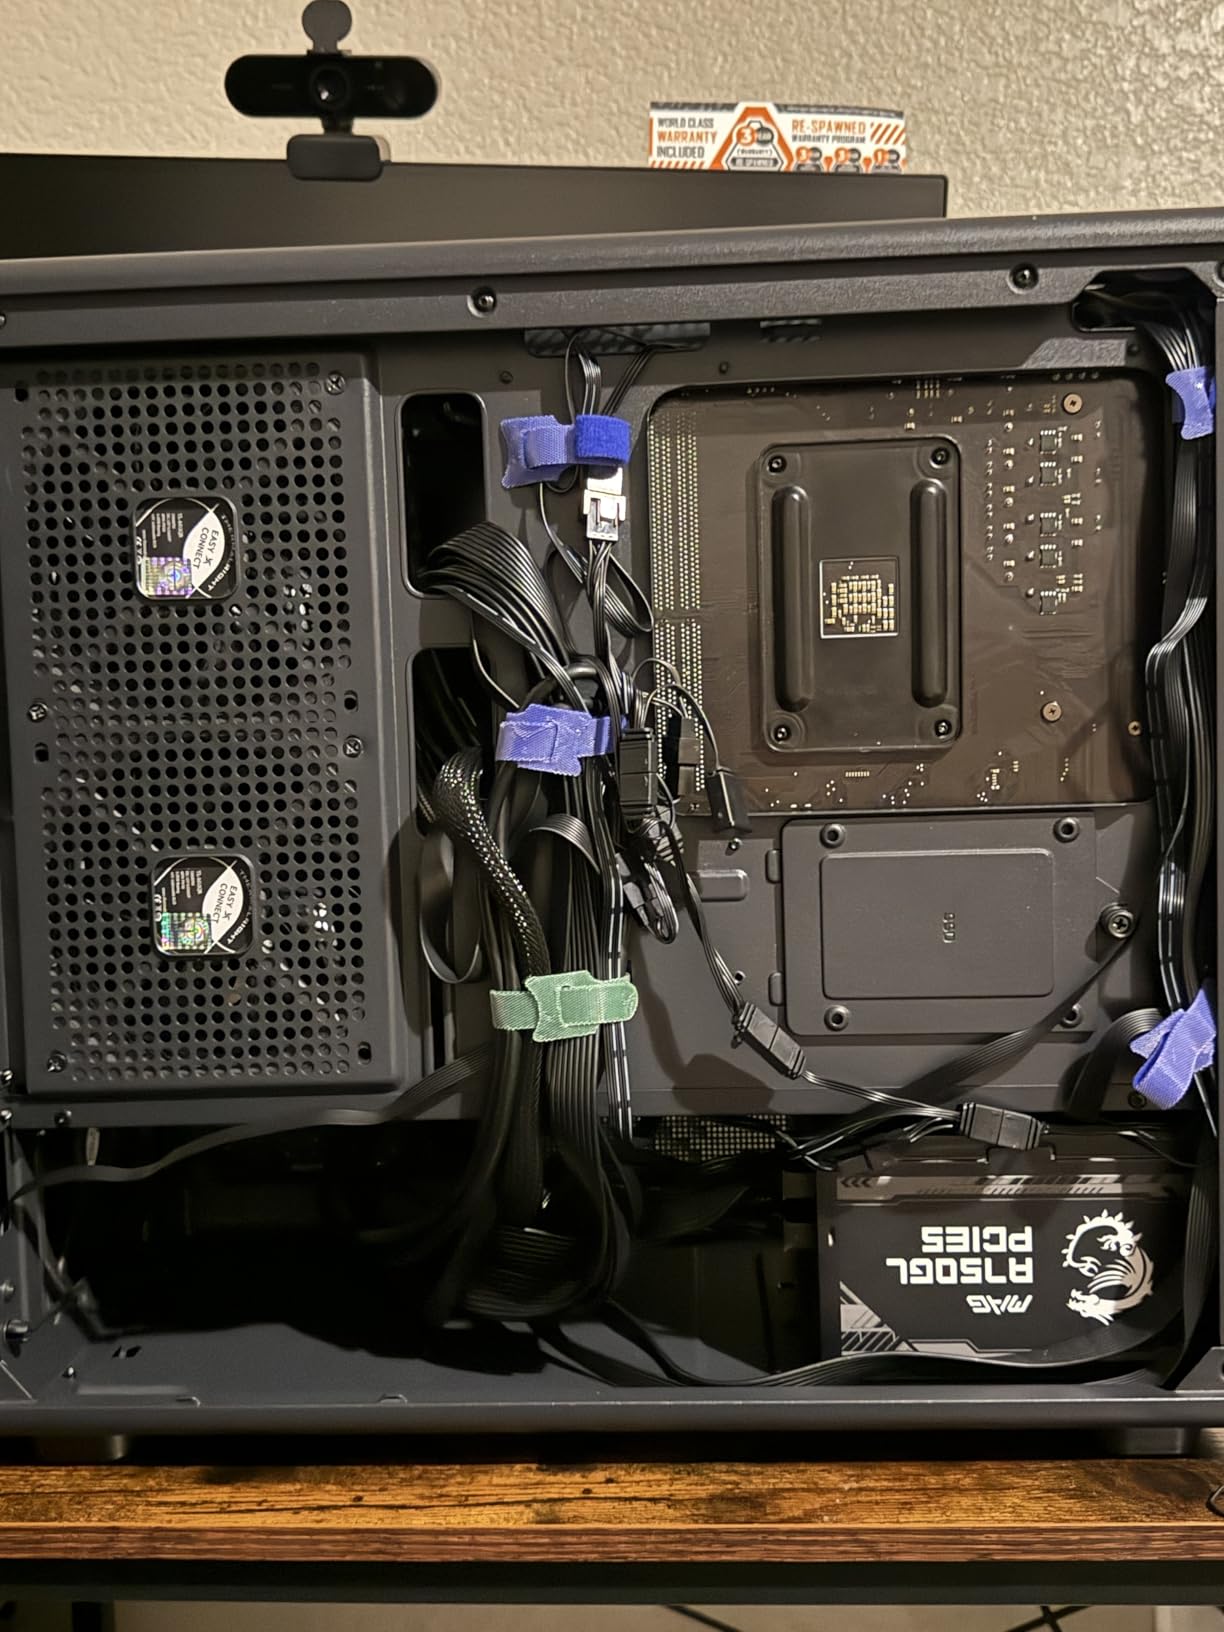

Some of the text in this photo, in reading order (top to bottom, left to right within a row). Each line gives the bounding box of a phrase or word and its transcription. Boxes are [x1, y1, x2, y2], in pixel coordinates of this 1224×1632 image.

[657, 117, 715, 129] WORLD CLASS
[791, 119, 867, 135] RE-SPAWNED
[657, 130, 718, 144] WARRANTY
[791, 134, 867, 144] WARRANTY PROGRAM
[656, 145, 706, 159] INCLUDED
[192, 527, 210, 570] CONNECT
[207, 529, 220, 554] EASY
[211, 883, 228, 924] CONNECT
[226, 884, 238, 909] EASY
[886, 1257, 1034, 1285] A750GL
[966, 1294, 1033, 1316] MAG
